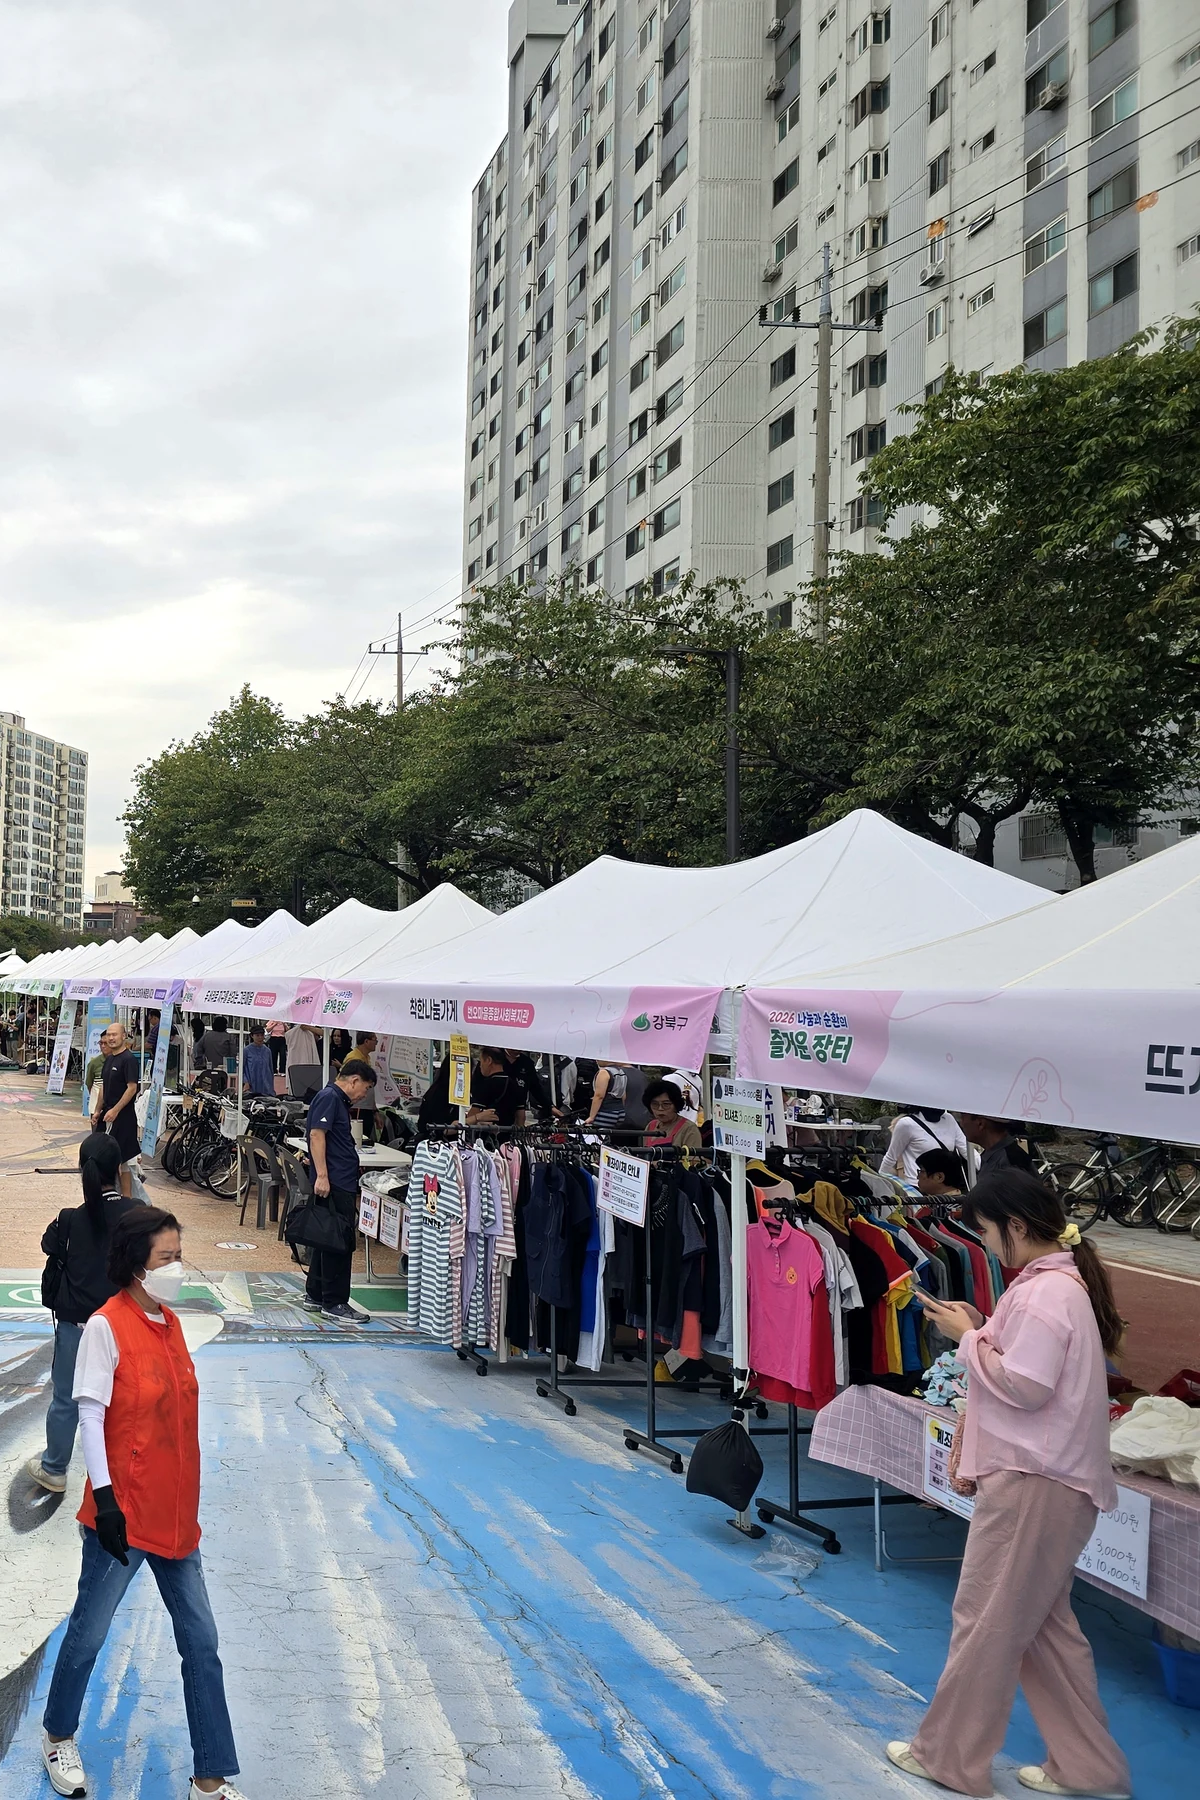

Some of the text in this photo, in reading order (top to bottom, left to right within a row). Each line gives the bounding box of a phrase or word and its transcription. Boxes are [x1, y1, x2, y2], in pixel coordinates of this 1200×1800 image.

[467, 1005, 529, 1024] 번오마을종합사회복지관
[769, 1011, 848, 1028] 2026 나눔과 순환의
[652, 1015, 689, 1031] 강북구
[770, 1029, 853, 1063] 즐거운 장터
[756, 1089, 762, 1102] 원
[724, 1108, 738, 1122] 티셔츠
[756, 1114, 762, 1127] 원
[756, 1140, 763, 1153] 원
[627, 1164, 640, 1179] 안내
